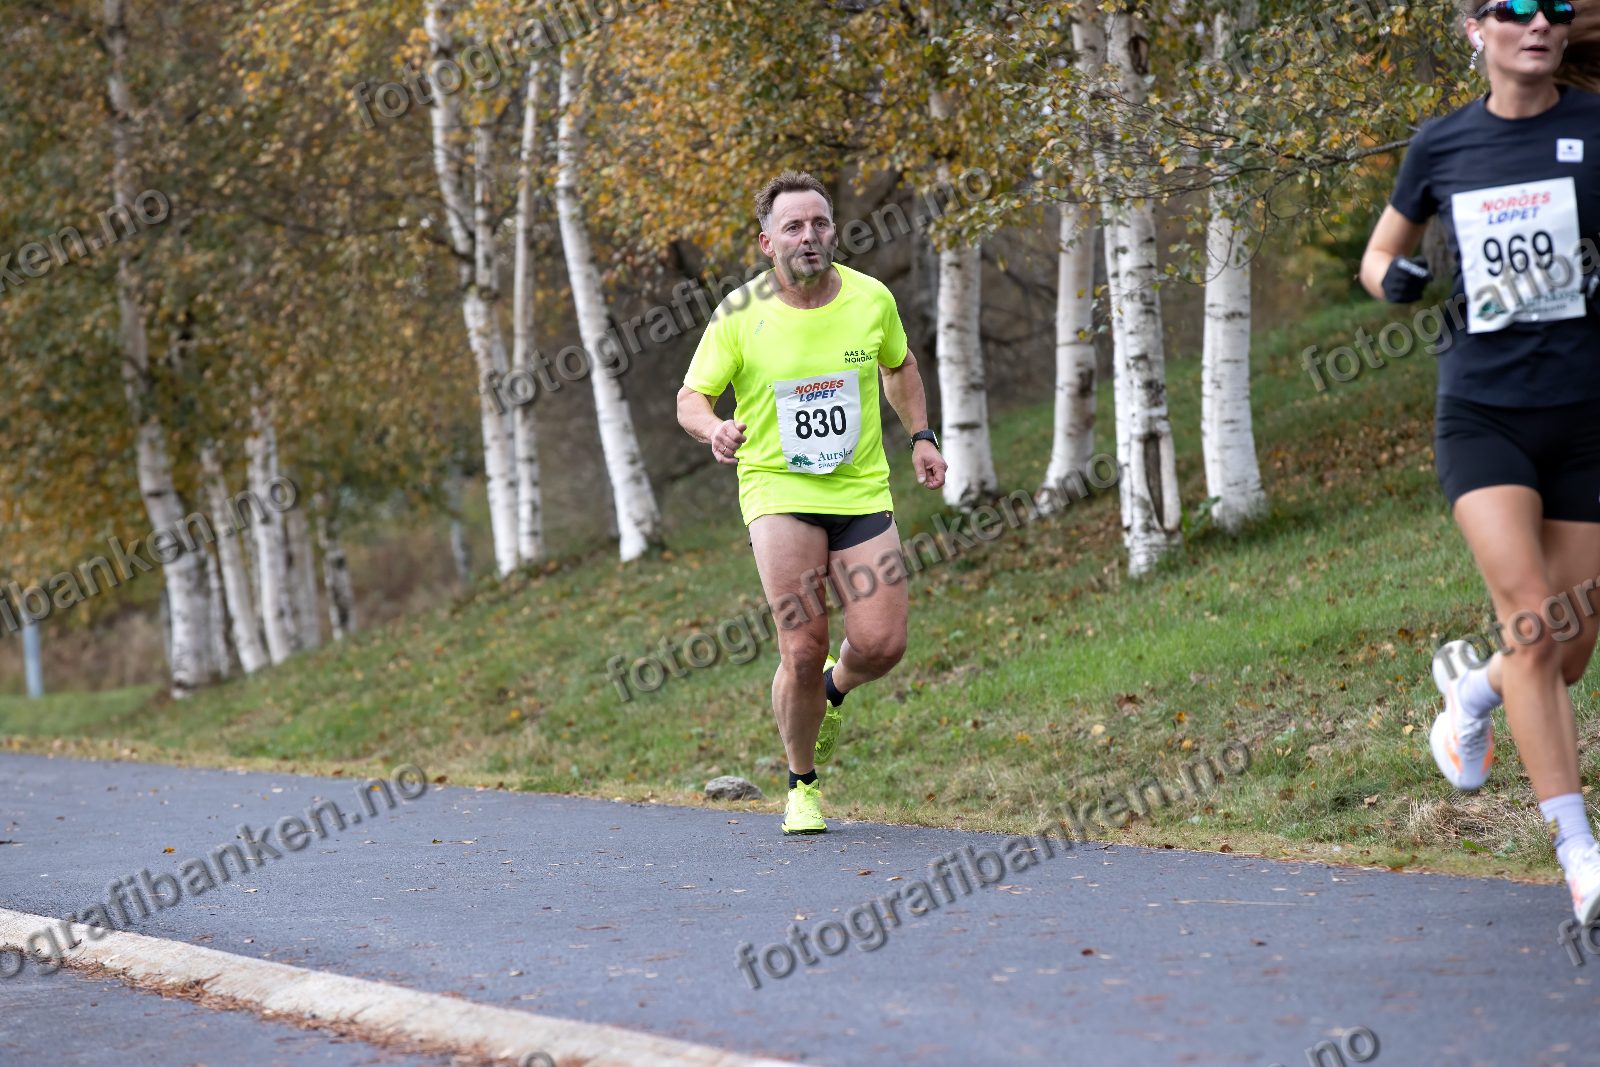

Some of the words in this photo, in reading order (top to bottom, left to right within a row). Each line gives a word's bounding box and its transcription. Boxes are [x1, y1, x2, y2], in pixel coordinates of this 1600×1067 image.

[1480, 191, 1551, 213] NORGES
[1483, 229, 1555, 277] 969
[794, 379, 845, 394] NORGES
[799, 389, 837, 402] LØPET
[795, 405, 847, 440] 830
